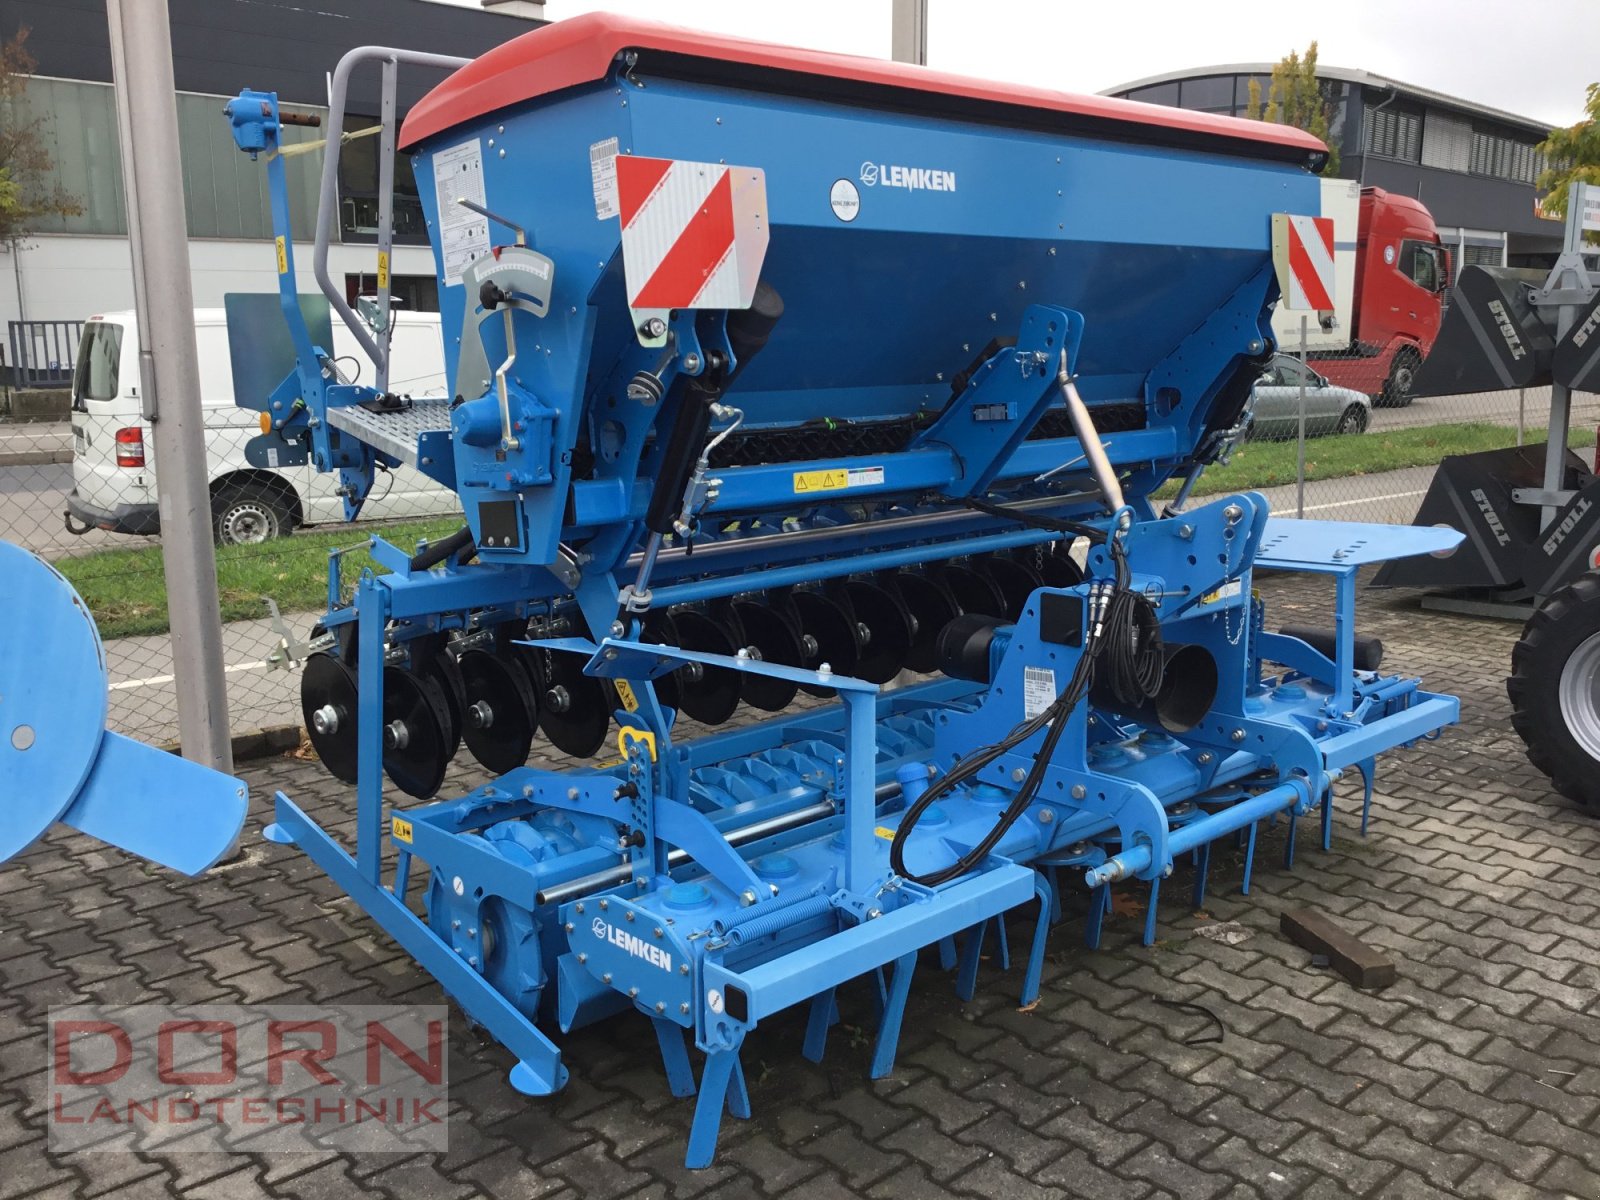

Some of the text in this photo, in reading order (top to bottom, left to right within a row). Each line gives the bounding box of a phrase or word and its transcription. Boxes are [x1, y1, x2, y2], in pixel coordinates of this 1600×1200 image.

[880, 164, 956, 193] LEMKEN
[1487, 299, 1527, 361] STOLL
[1572, 303, 1600, 349] STO
[1470, 487, 1512, 547] STOLL
[1542, 497, 1593, 557] STOLL
[607, 923, 672, 973] LEMKEN
